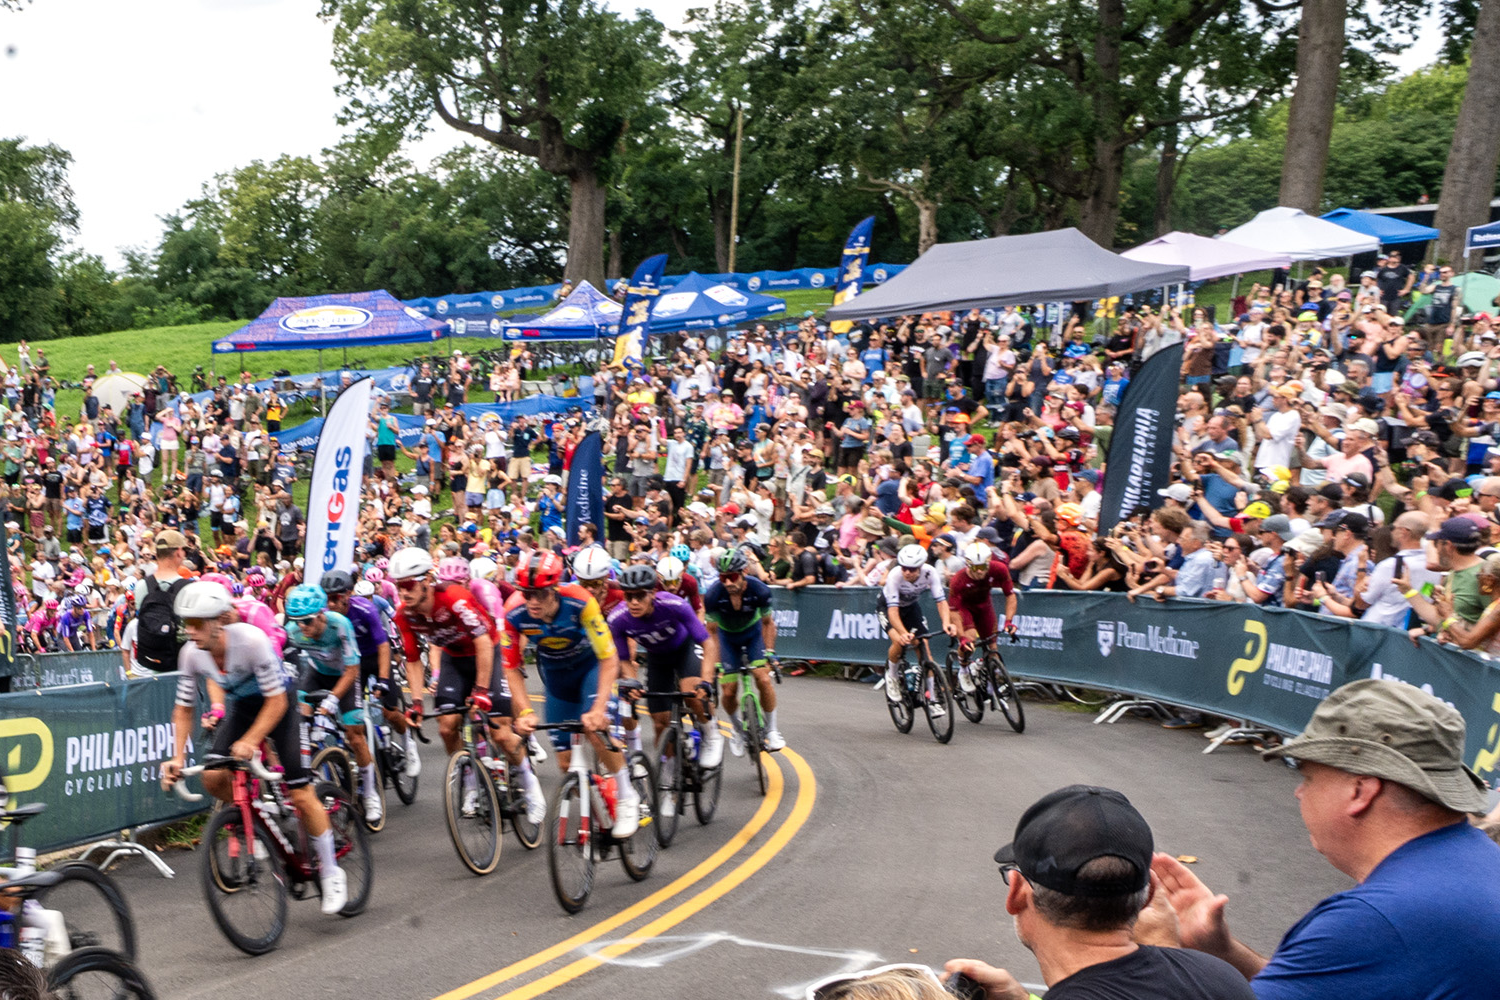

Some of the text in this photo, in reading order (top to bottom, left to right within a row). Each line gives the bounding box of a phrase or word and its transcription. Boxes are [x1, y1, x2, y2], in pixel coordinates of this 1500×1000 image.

[322, 445, 352, 572] eriGas
[64, 722, 196, 776] PHILADELPHA
[64, 769, 133, 797] CYCLING
